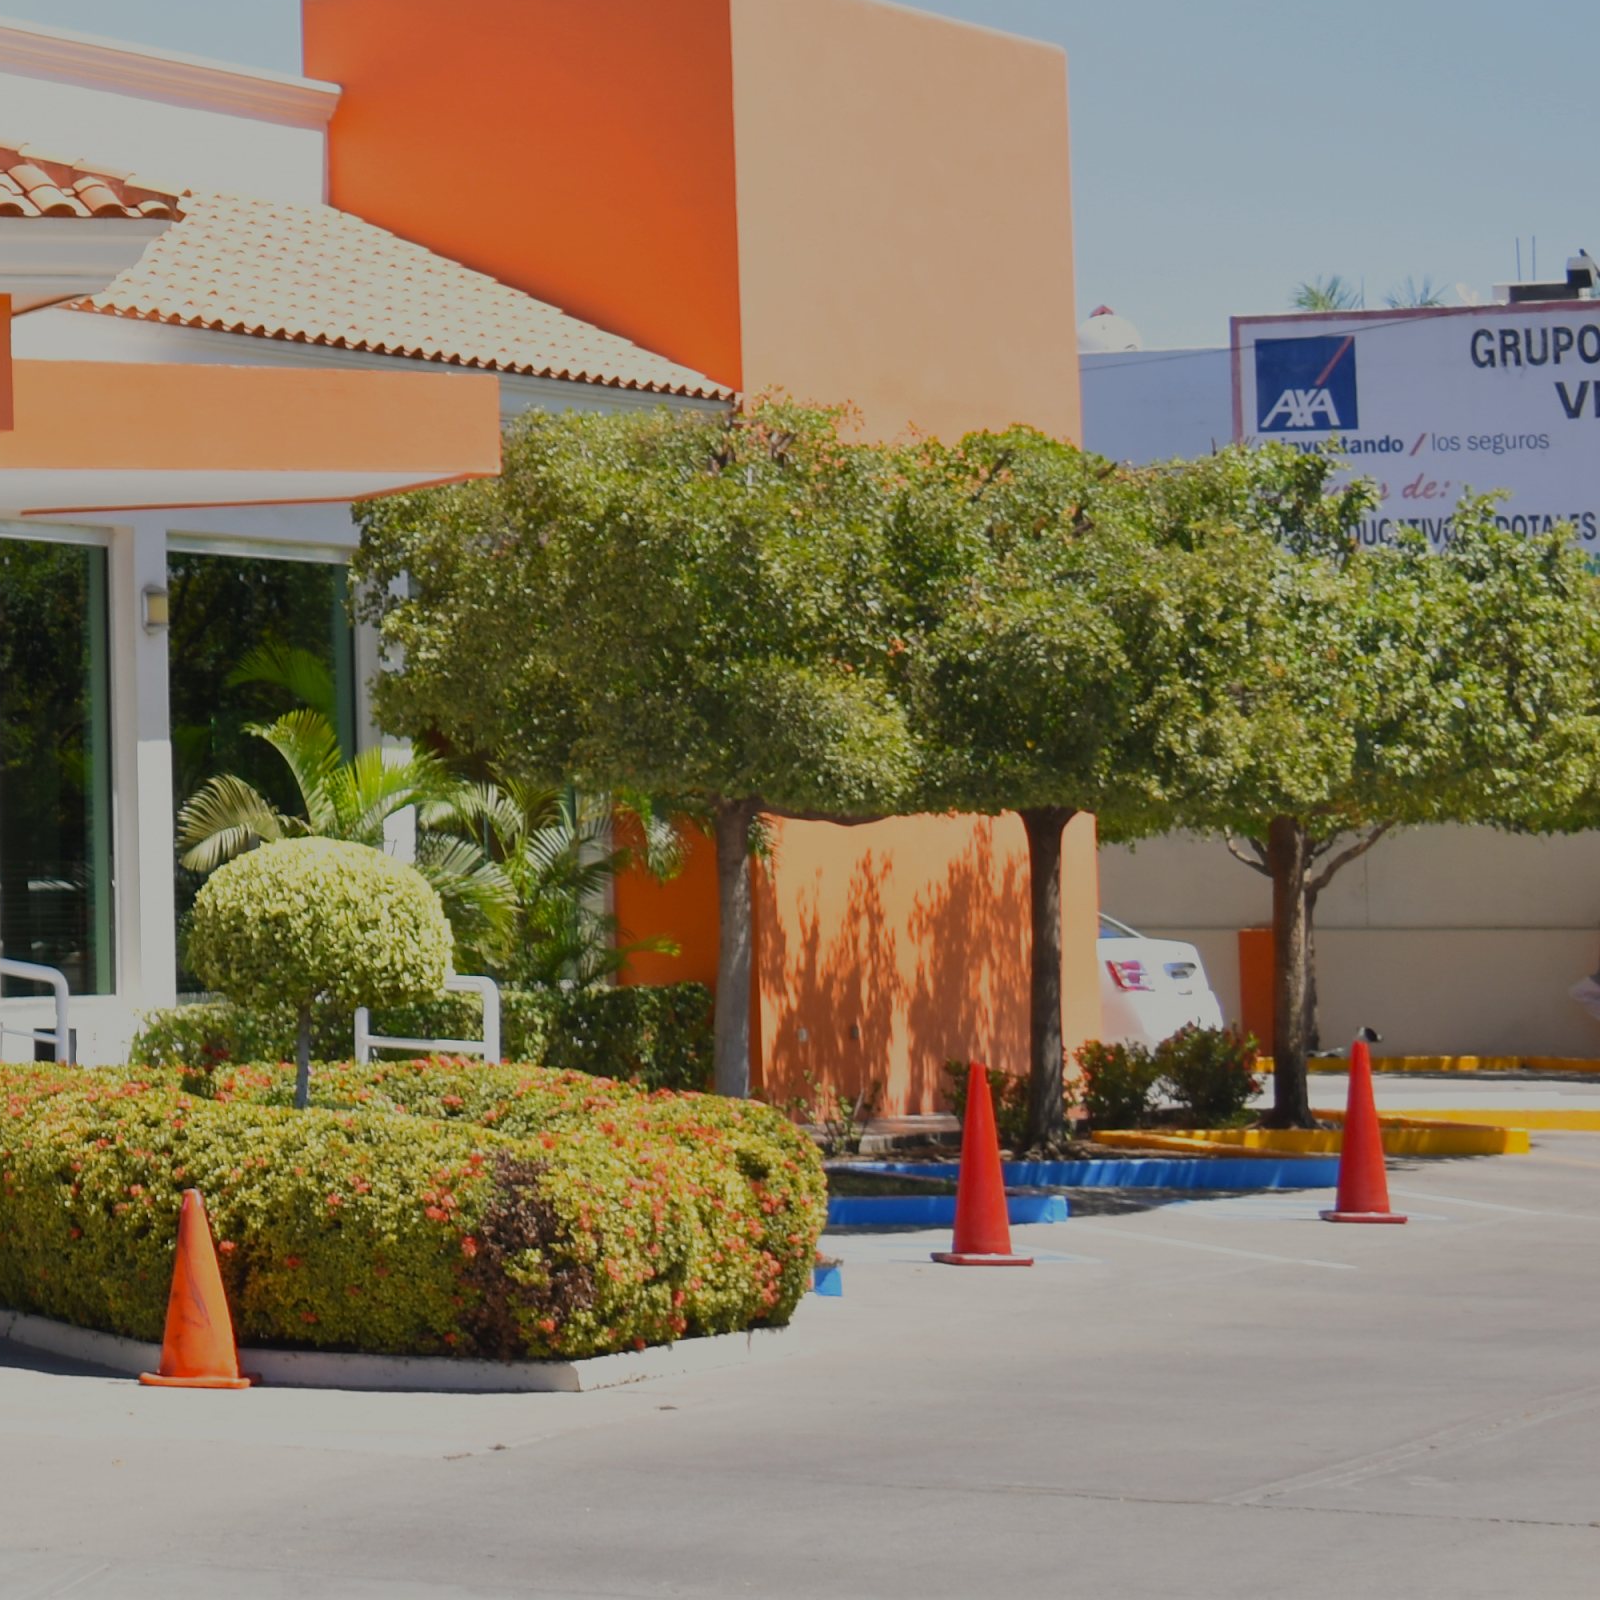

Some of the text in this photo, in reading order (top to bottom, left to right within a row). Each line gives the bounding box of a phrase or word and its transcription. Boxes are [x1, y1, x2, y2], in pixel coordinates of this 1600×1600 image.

[1470, 323, 1600, 369] GRUPO
[1260, 388, 1341, 428] AXA
[1431, 433, 1461, 451] los
[1467, 432, 1551, 455] seguros
[1402, 472, 1451, 499] de:
